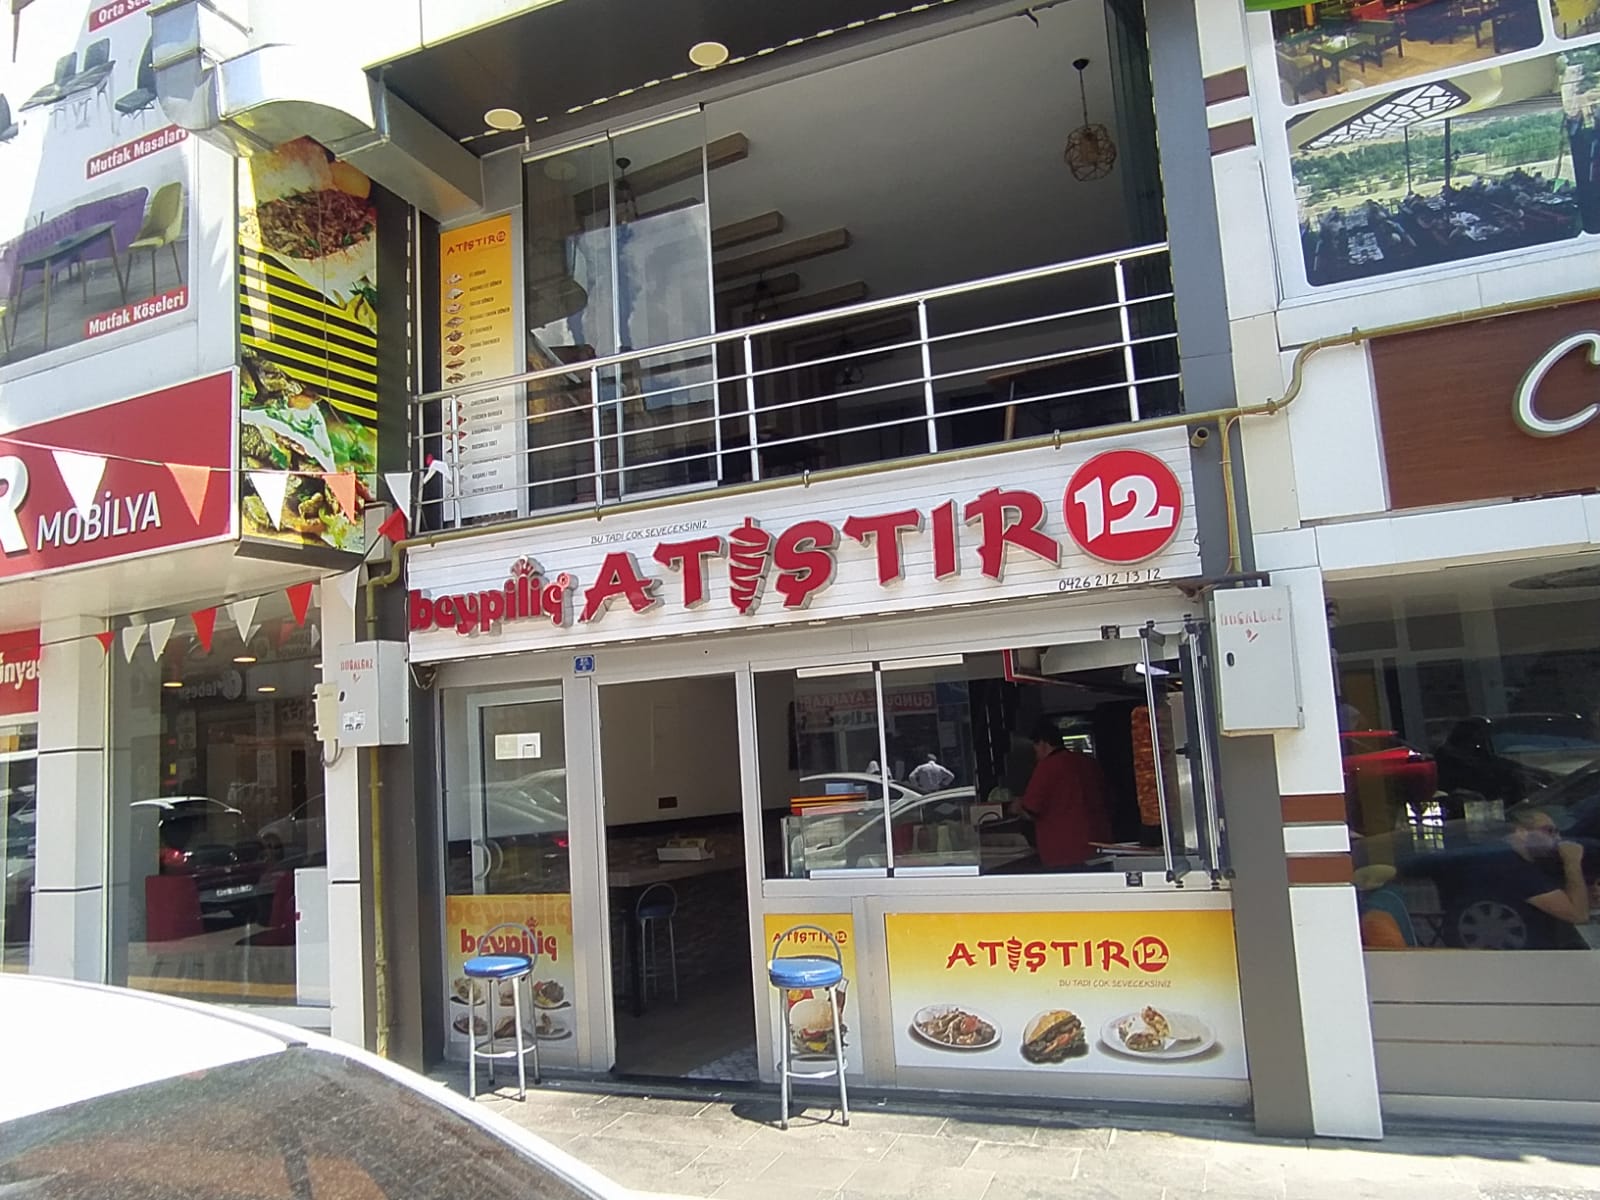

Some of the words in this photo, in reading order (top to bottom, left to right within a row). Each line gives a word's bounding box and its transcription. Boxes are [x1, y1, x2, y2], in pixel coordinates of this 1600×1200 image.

[98, 3, 125, 23] Orta
[90, 147, 131, 175] Mutfak
[89, 308, 130, 335] Mutfak
[133, 291, 185, 321] Köşeleri
[36, 490, 162, 551] MOBİLYA
[1074, 474, 1175, 543] 12
[1058, 576, 1091, 591] 0426
[1095, 573, 1120, 586] 212
[1126, 571, 1140, 583] 13
[1147, 568, 1161, 580] 12
[1134, 940, 1169, 965] 12
